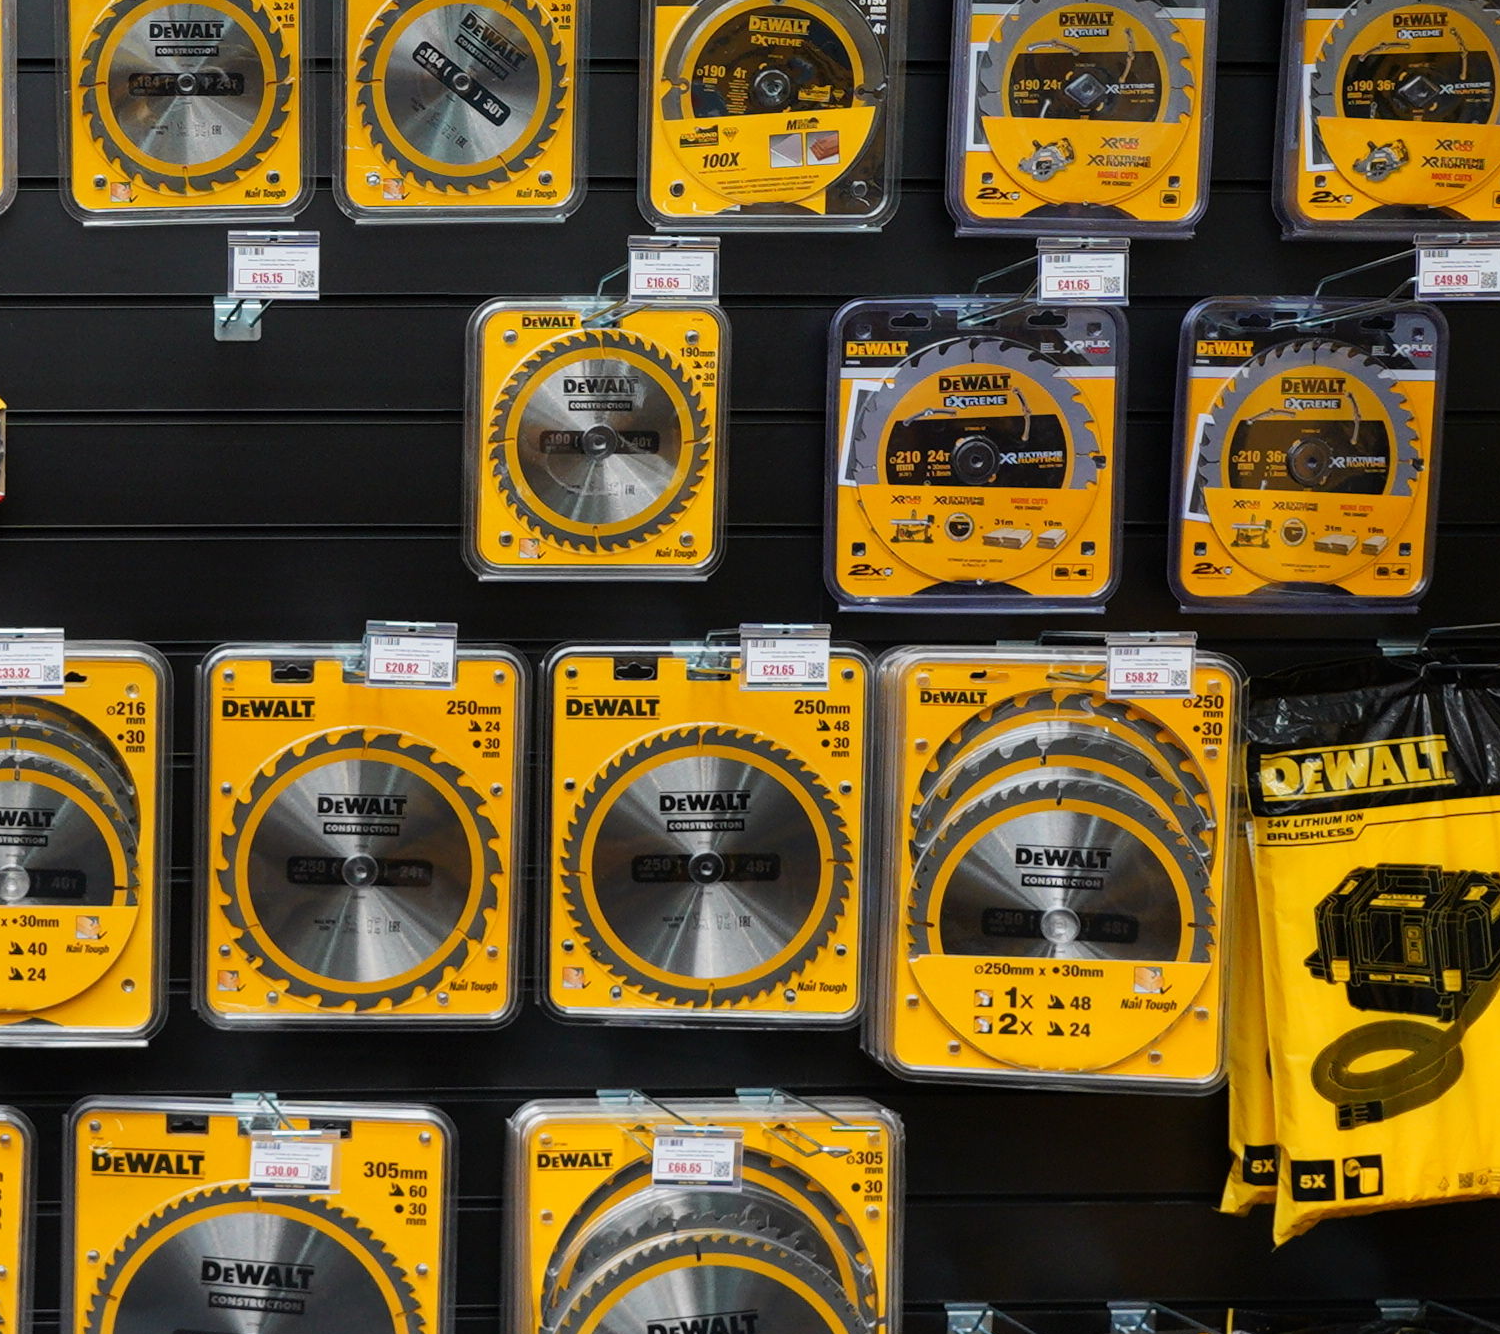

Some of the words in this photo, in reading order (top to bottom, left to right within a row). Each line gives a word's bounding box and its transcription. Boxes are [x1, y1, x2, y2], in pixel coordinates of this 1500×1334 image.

[251, 273, 284, 283] £15.15
[647, 278, 680, 289] £16.65
[1434, 275, 1468, 286] £49.99
[1058, 280, 1090, 291] £41.65
[384, 663, 418, 675] £20.82
[762, 665, 795, 676] £21.65
[1125, 673, 1158, 683] £58.32
[222, 700, 315, 718] DEWALT
[447, 700, 501, 715] 250mm
[566, 699, 660, 716] DEWALT
[794, 699, 850, 714] 250mm
[485, 721, 500, 732] 24
[1260, 735, 1456, 798] DEWALT
[1267, 820, 1289, 829] 54V
[1294, 815, 1341, 828] LITHIUM
[1346, 813, 1364, 822] ION
[1267, 826, 1355, 843] BRUSHLESS
[797, 980, 816, 991] Nail
[819, 982, 847, 994] Tough
[92, 1151, 204, 1175] DEWALT
[668, 1163, 701, 1173] £66.65
[1251, 1160, 1274, 1173] 5X
[265, 1166, 299, 1177] £30.00
[364, 1161, 427, 1180] 305mm
[1300, 1174, 1326, 1188] 5X
[409, 1185, 427, 1198] 60
